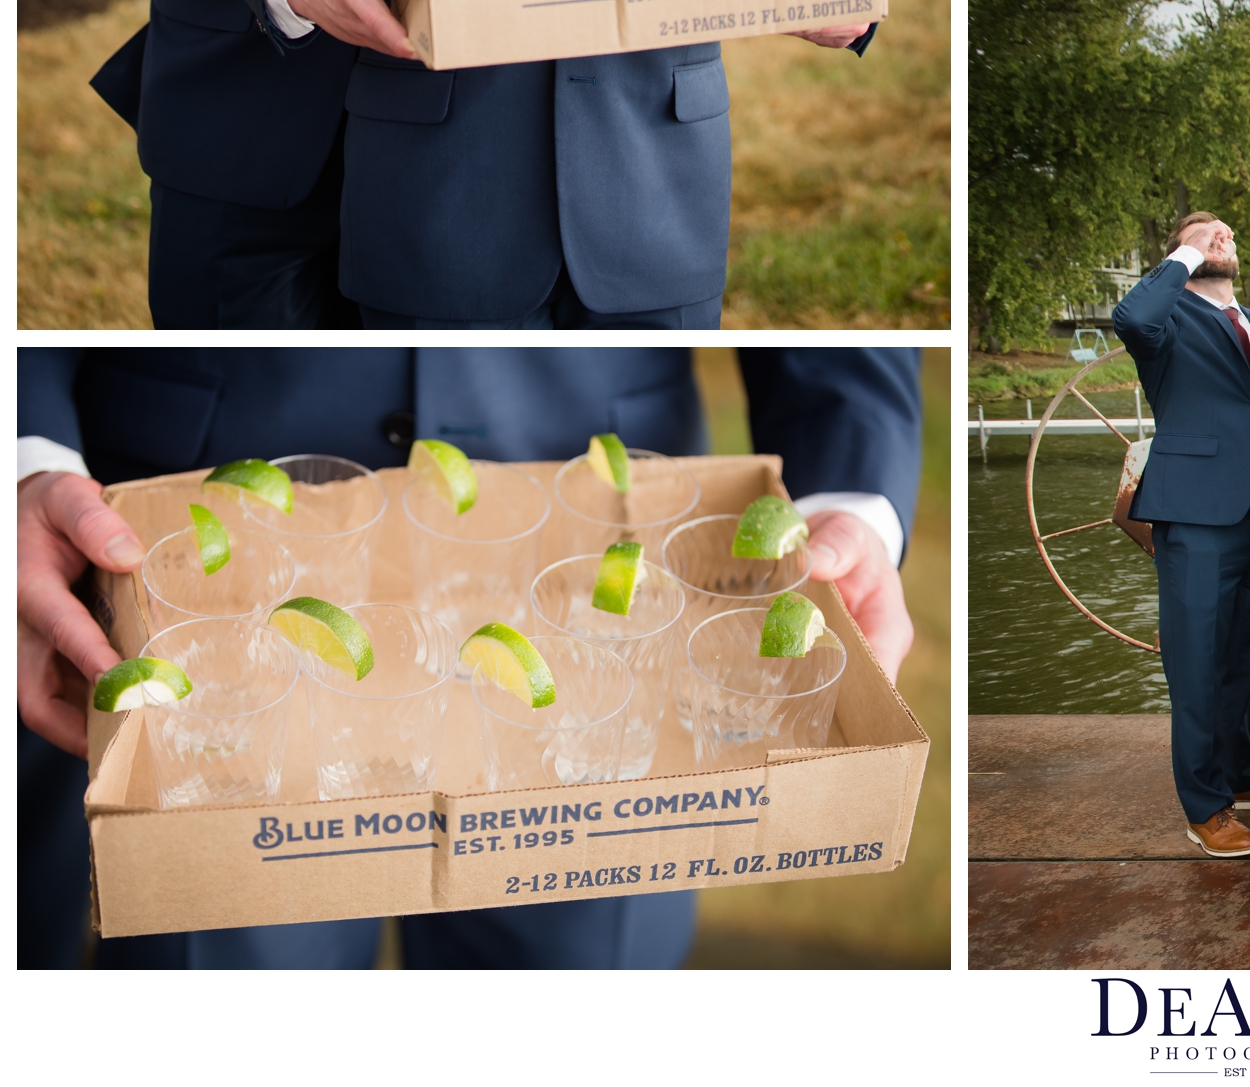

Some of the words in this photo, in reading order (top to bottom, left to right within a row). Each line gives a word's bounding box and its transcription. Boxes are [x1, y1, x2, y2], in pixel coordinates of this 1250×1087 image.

[659, 18, 689, 37] 2-12
[692, 13, 736, 33] PACKS
[741, 11, 756, 28] 12
[761, 8, 786, 25] FL.
[253, 816, 344, 850] BLUE
[354, 810, 448, 837] MOON
[459, 801, 603, 834] BREWING
[453, 834, 506, 857] EST.
[513, 829, 576, 850] 1995
[505, 872, 558, 895] 2-12
[564, 865, 642, 890] PACKS
[649, 862, 677, 882] 12
[687, 858, 728, 879] FL.
